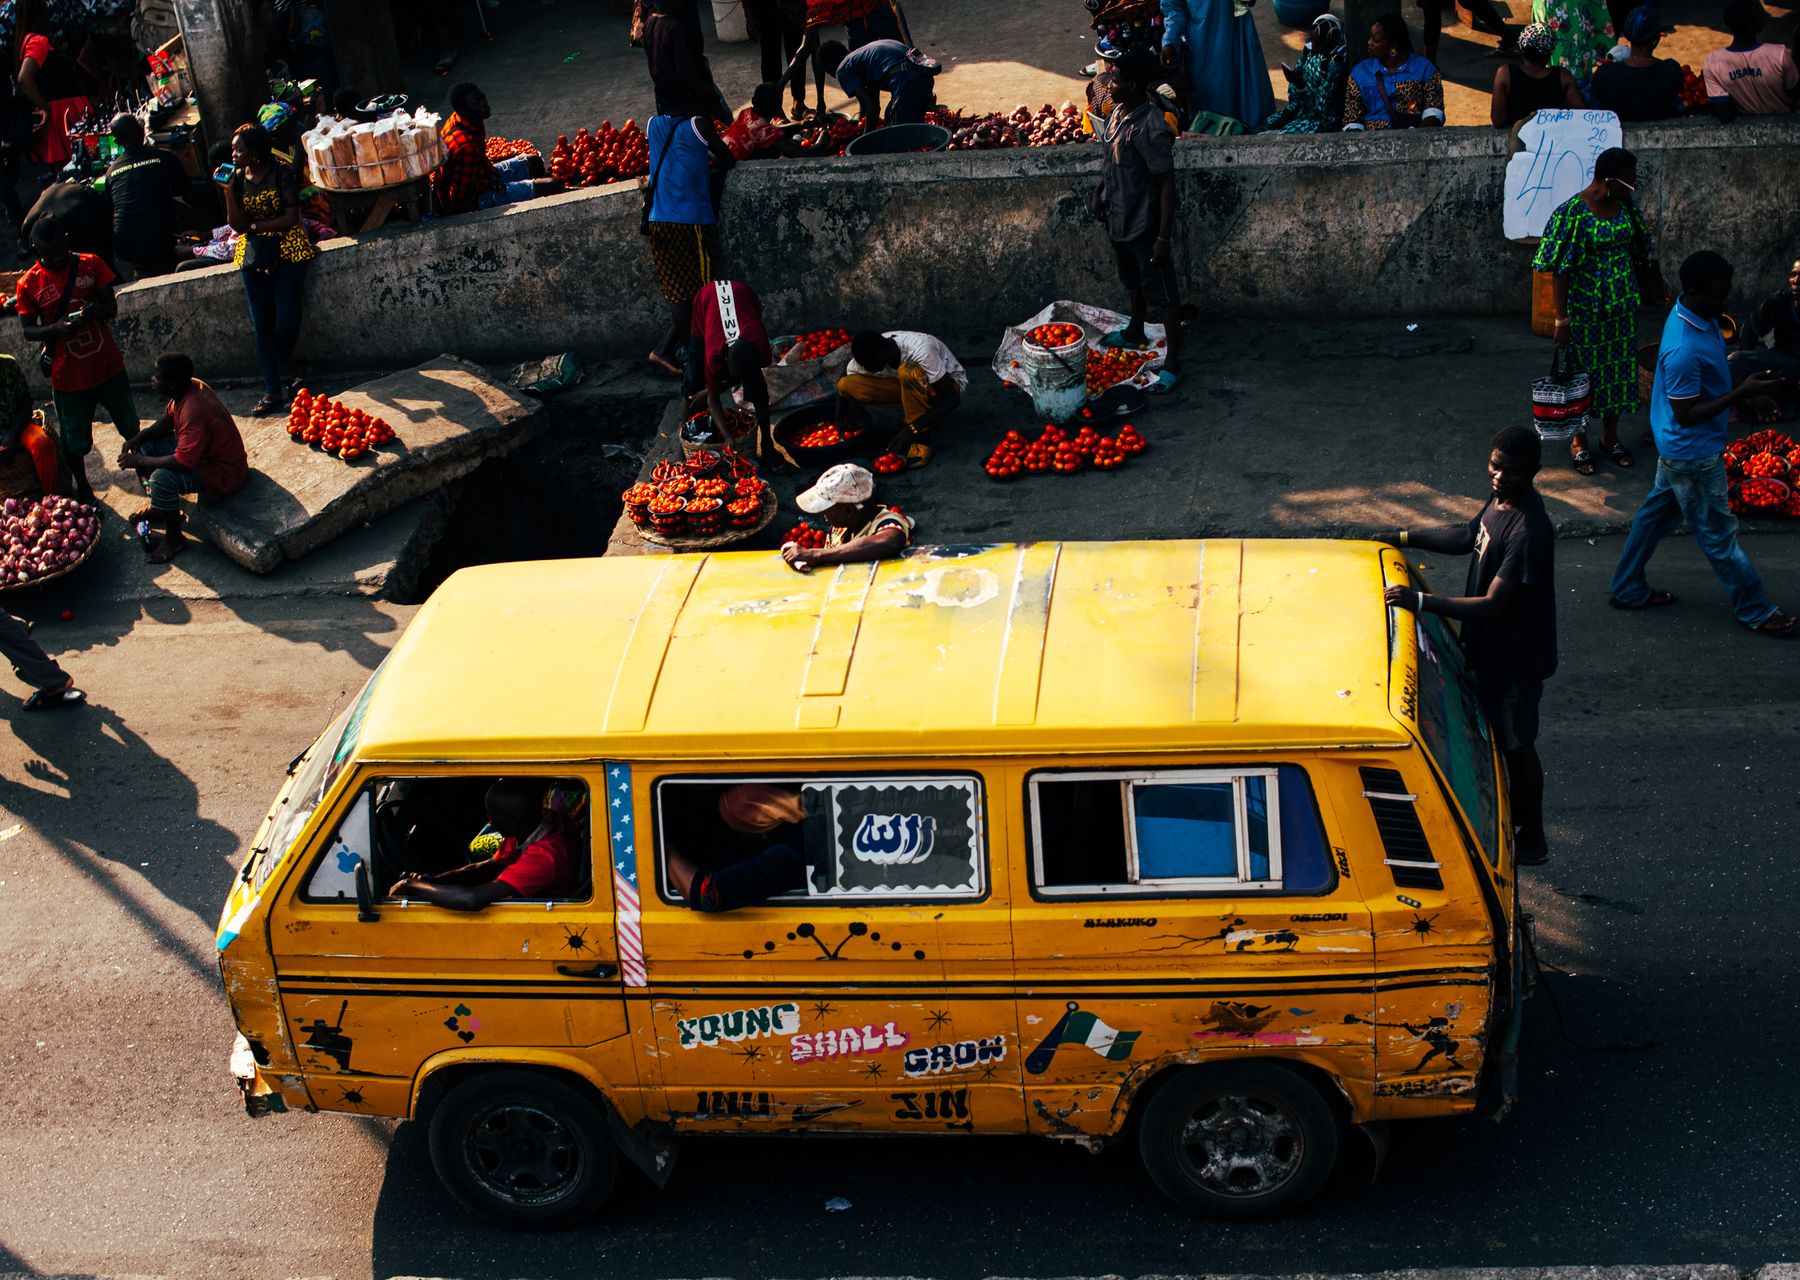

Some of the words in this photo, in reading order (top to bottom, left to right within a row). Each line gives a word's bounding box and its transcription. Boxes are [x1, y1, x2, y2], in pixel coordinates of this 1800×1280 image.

[1587, 127, 1608, 143] 20
[1516, 130, 1585, 218] 40
[789, 1020, 910, 1065] SHALL
[904, 1034, 1007, 1077] GROW
